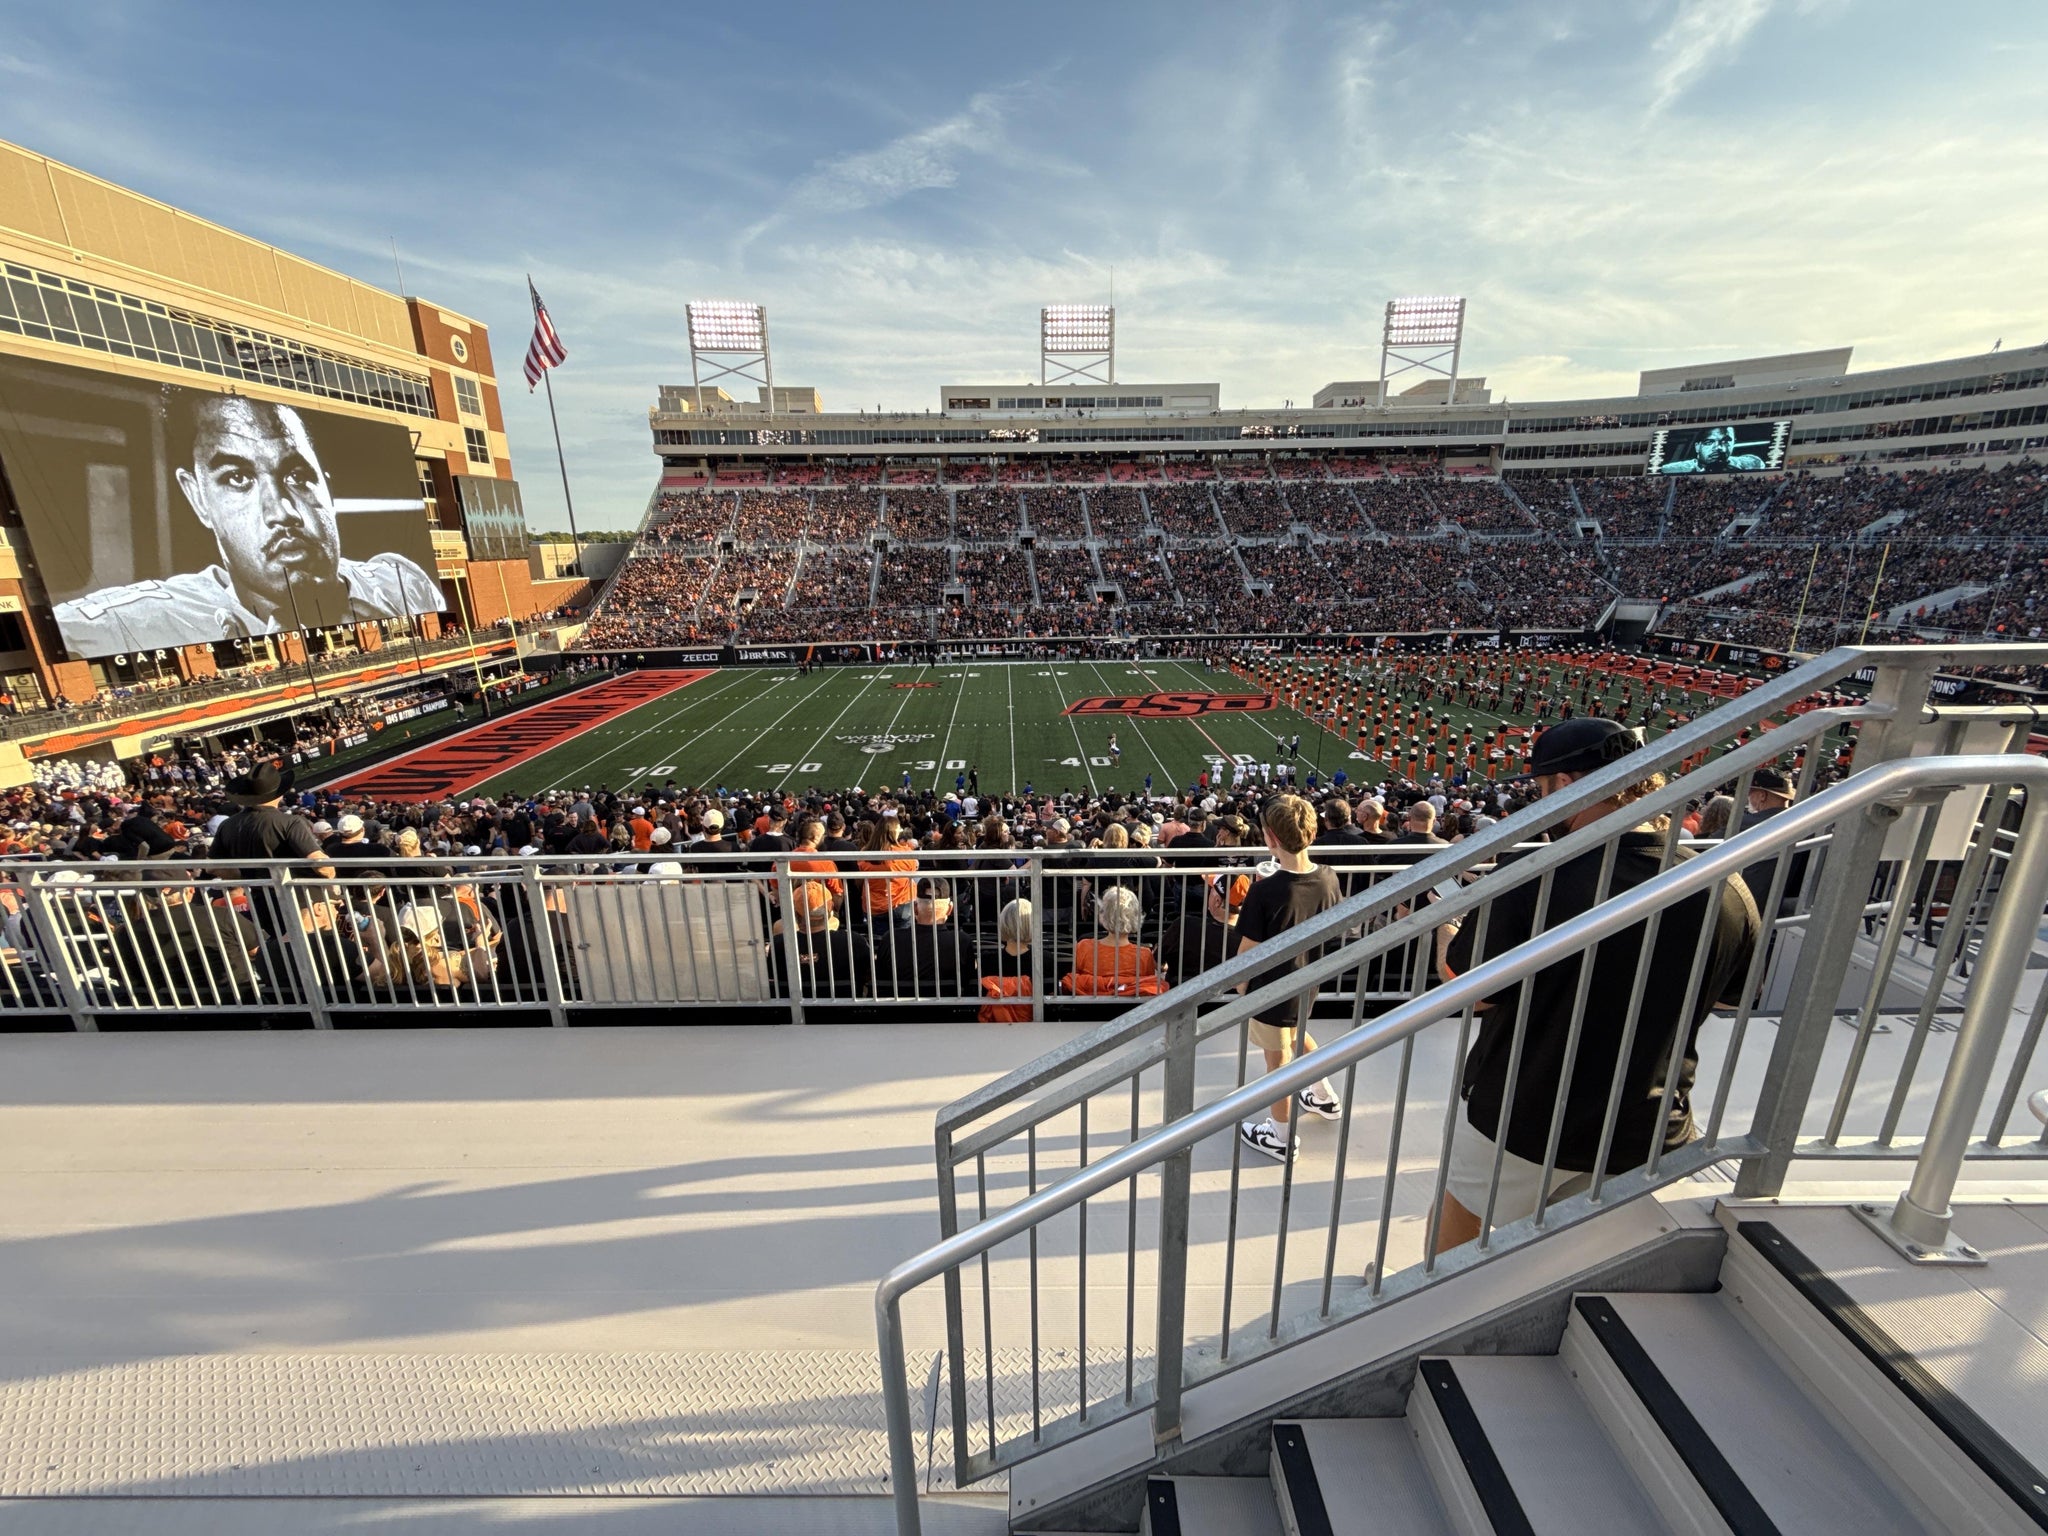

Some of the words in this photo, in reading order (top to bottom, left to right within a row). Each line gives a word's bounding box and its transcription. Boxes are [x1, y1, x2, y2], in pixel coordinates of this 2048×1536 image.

[115, 647, 184, 666] GARY
[206, 643, 215, 653] &
[233, 628, 324, 649] CLAUDIA
[337, 614, 426, 634] HUMPHREYS
[682, 654, 719, 662] ZEECO
[1855, 668, 1876, 682] NATI
[581, 673, 694, 702] STATE
[398, 706, 422, 720] NATIONAL
[422, 698, 448, 713] CHAMPIONS
[340, 702, 625, 795] OKLAHOMA
[914, 759, 967, 770] 30
[1060, 756, 1112, 767] 40
[1202, 754, 1258, 764] 50
[628, 765, 678, 777] 10
[766, 762, 823, 774] 20
